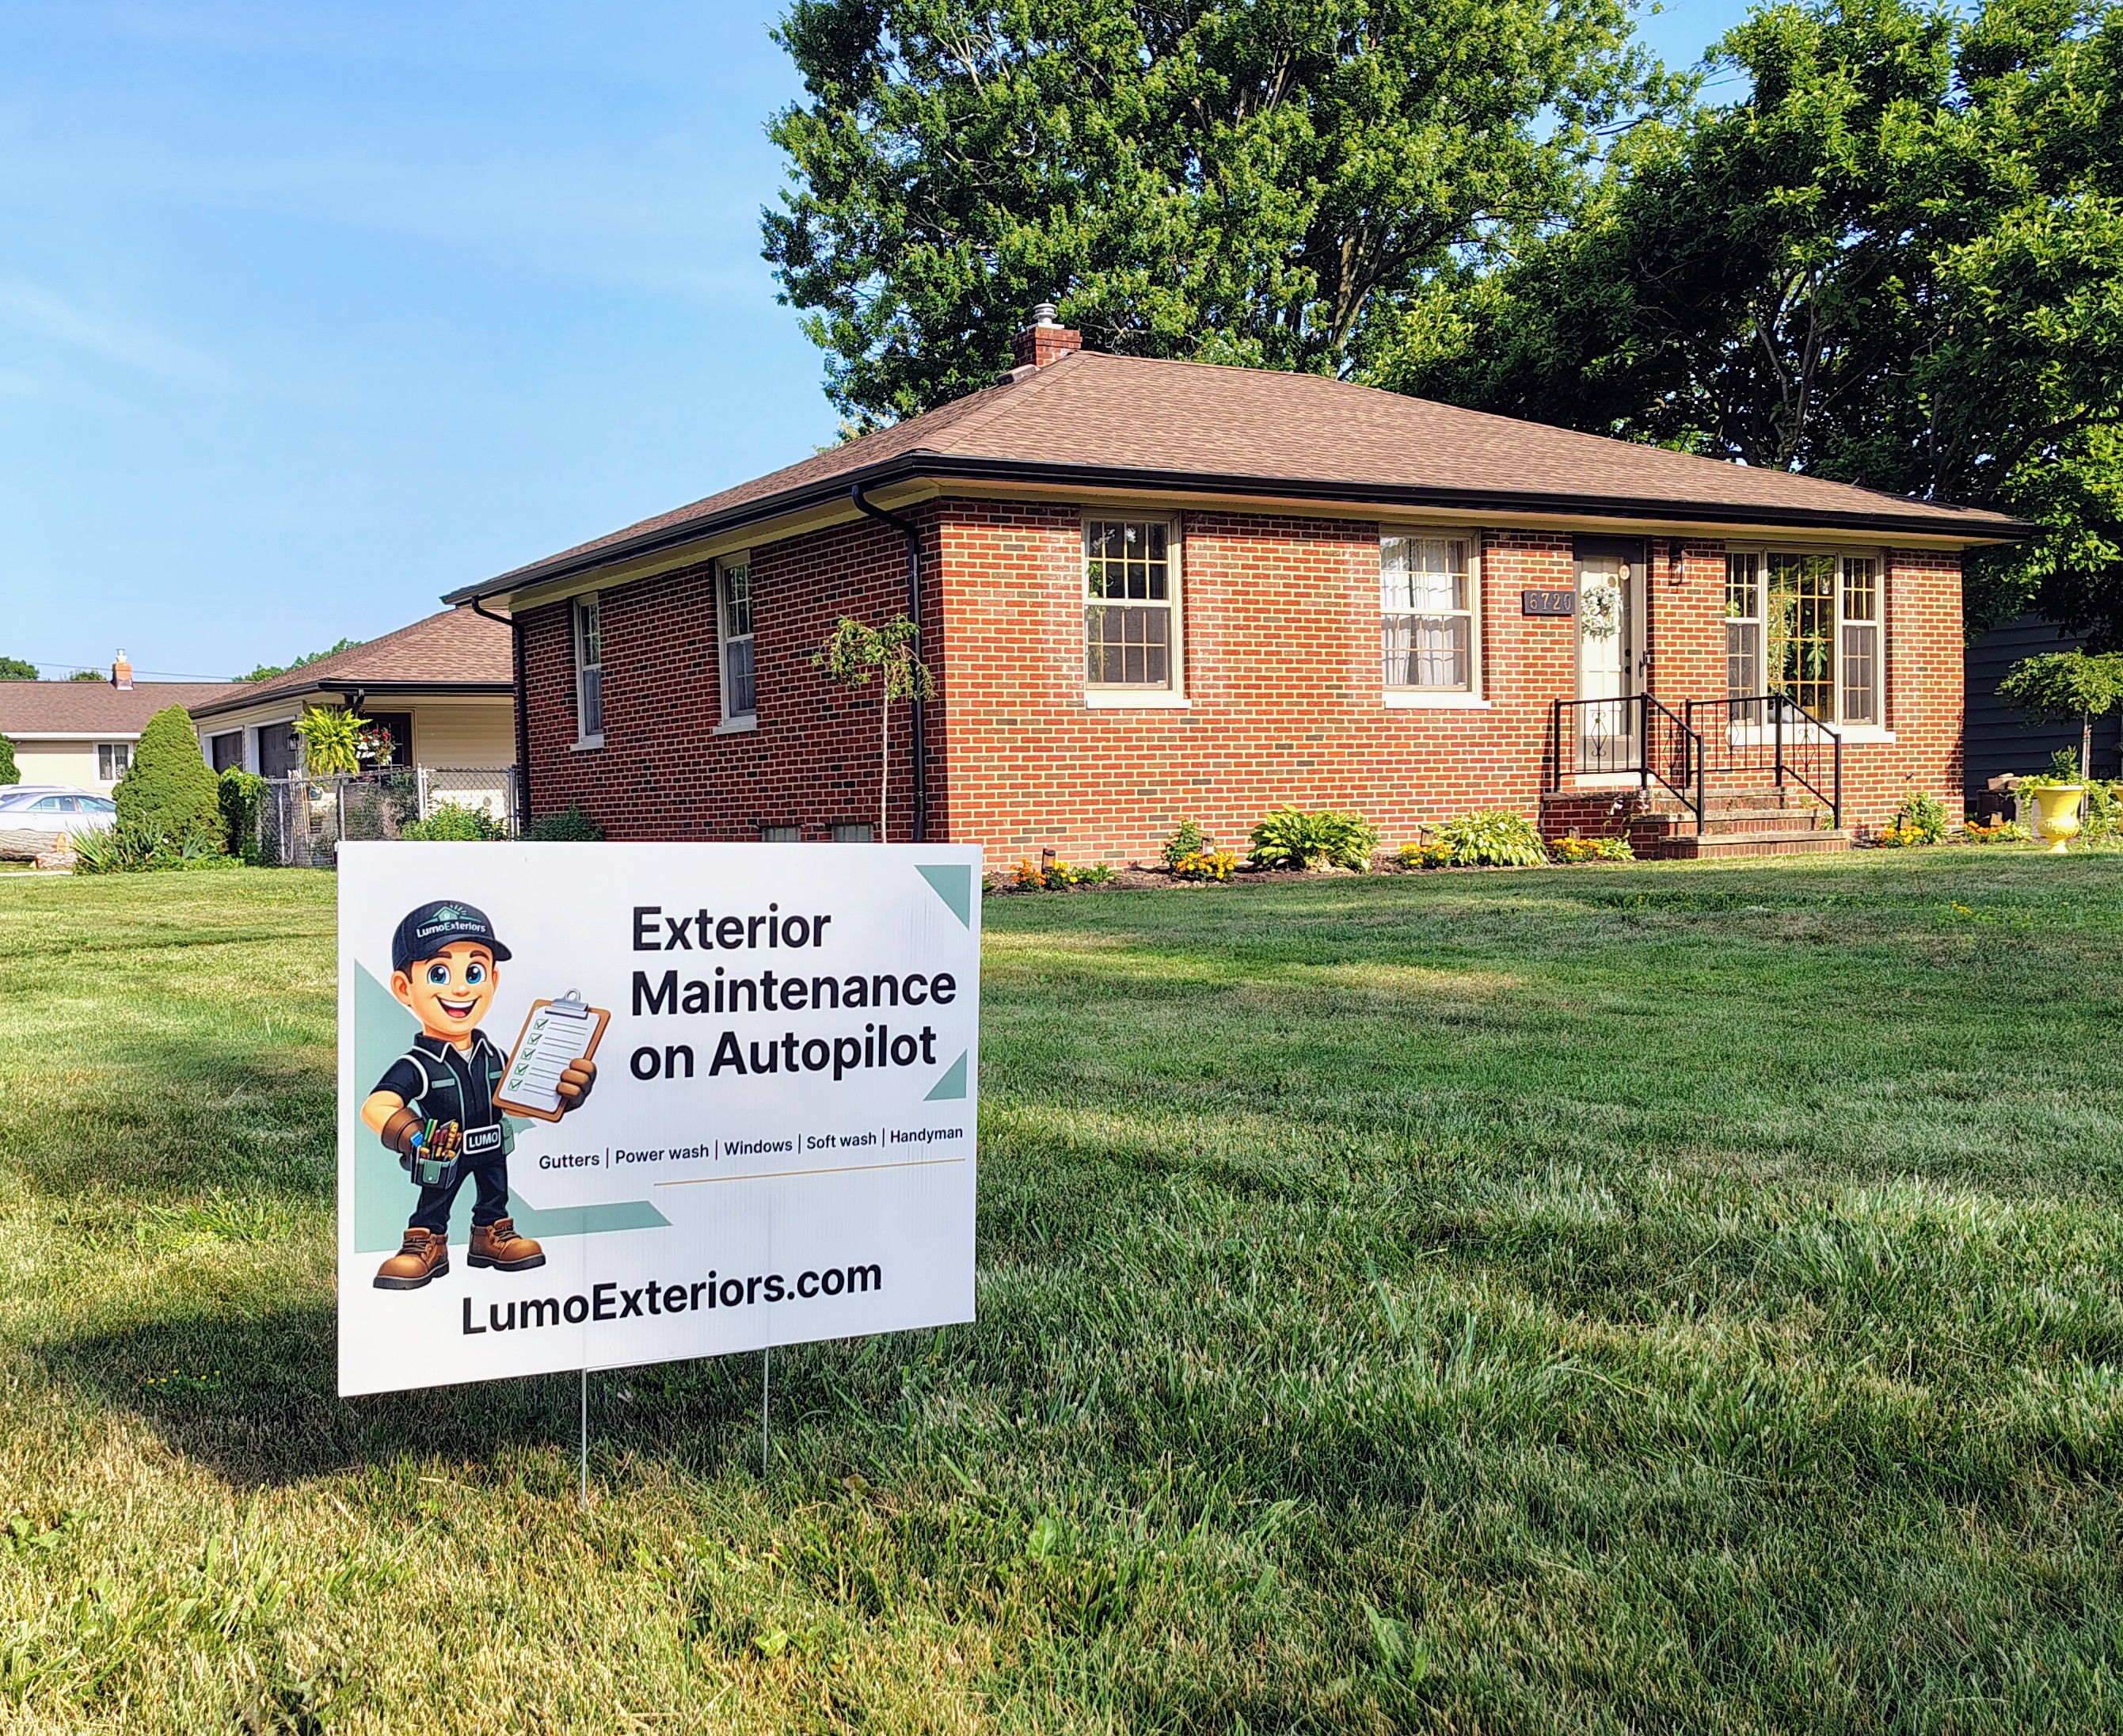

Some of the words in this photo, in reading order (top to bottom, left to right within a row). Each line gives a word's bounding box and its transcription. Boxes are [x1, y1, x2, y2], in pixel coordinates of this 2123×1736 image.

[1529, 592, 1572, 611] 6720
[417, 921, 486, 938] LumoExteriors
[633, 902, 831, 951] Exterior
[632, 966, 957, 1016] Maintenance
[630, 1045, 694, 1081] on
[708, 1022, 937, 1081] Autopilot
[469, 1131, 499, 1148] LUMO
[538, 1154, 600, 1170] Gutters
[615, 1150, 665, 1164] Power
[668, 1144, 710, 1160] wash
[724, 1139, 793, 1156] Windows
[807, 1134, 836, 1150] Soft
[839, 1132, 877, 1147] wash
[890, 1128, 963, 1144] Handyman
[462, 1264, 881, 1335] LumoExteriors.com
